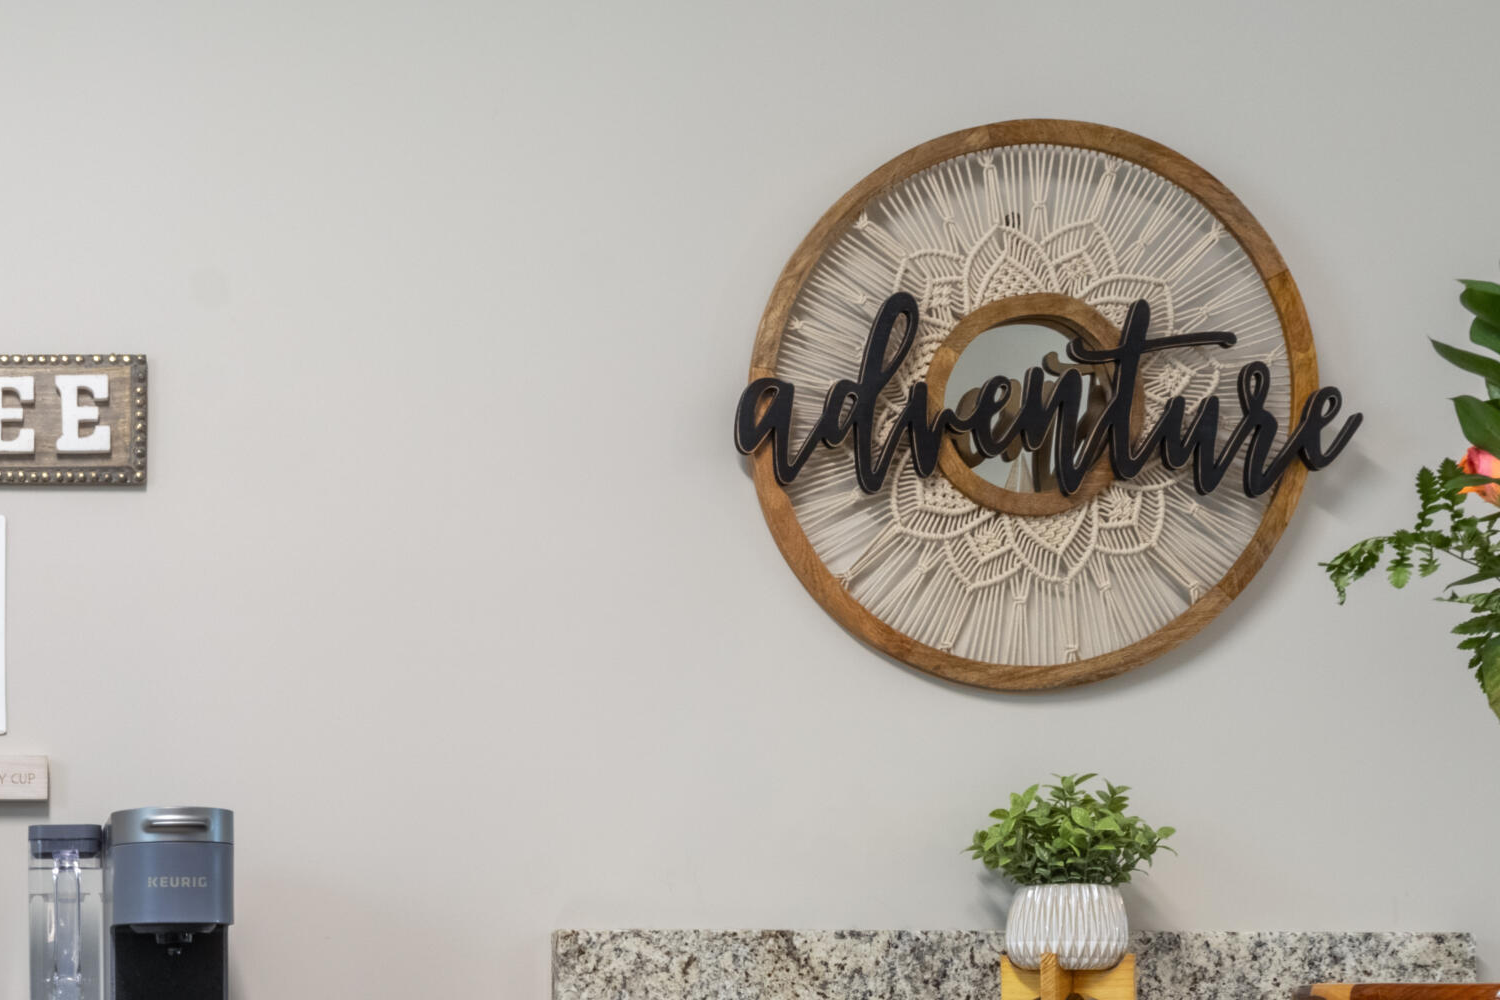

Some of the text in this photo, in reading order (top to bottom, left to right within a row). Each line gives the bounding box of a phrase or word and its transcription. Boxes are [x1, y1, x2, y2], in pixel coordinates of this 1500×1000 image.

[735, 292, 1363, 499] adventure
[11, 773, 36, 785] CUP
[147, 876, 208, 888] KEURIG
